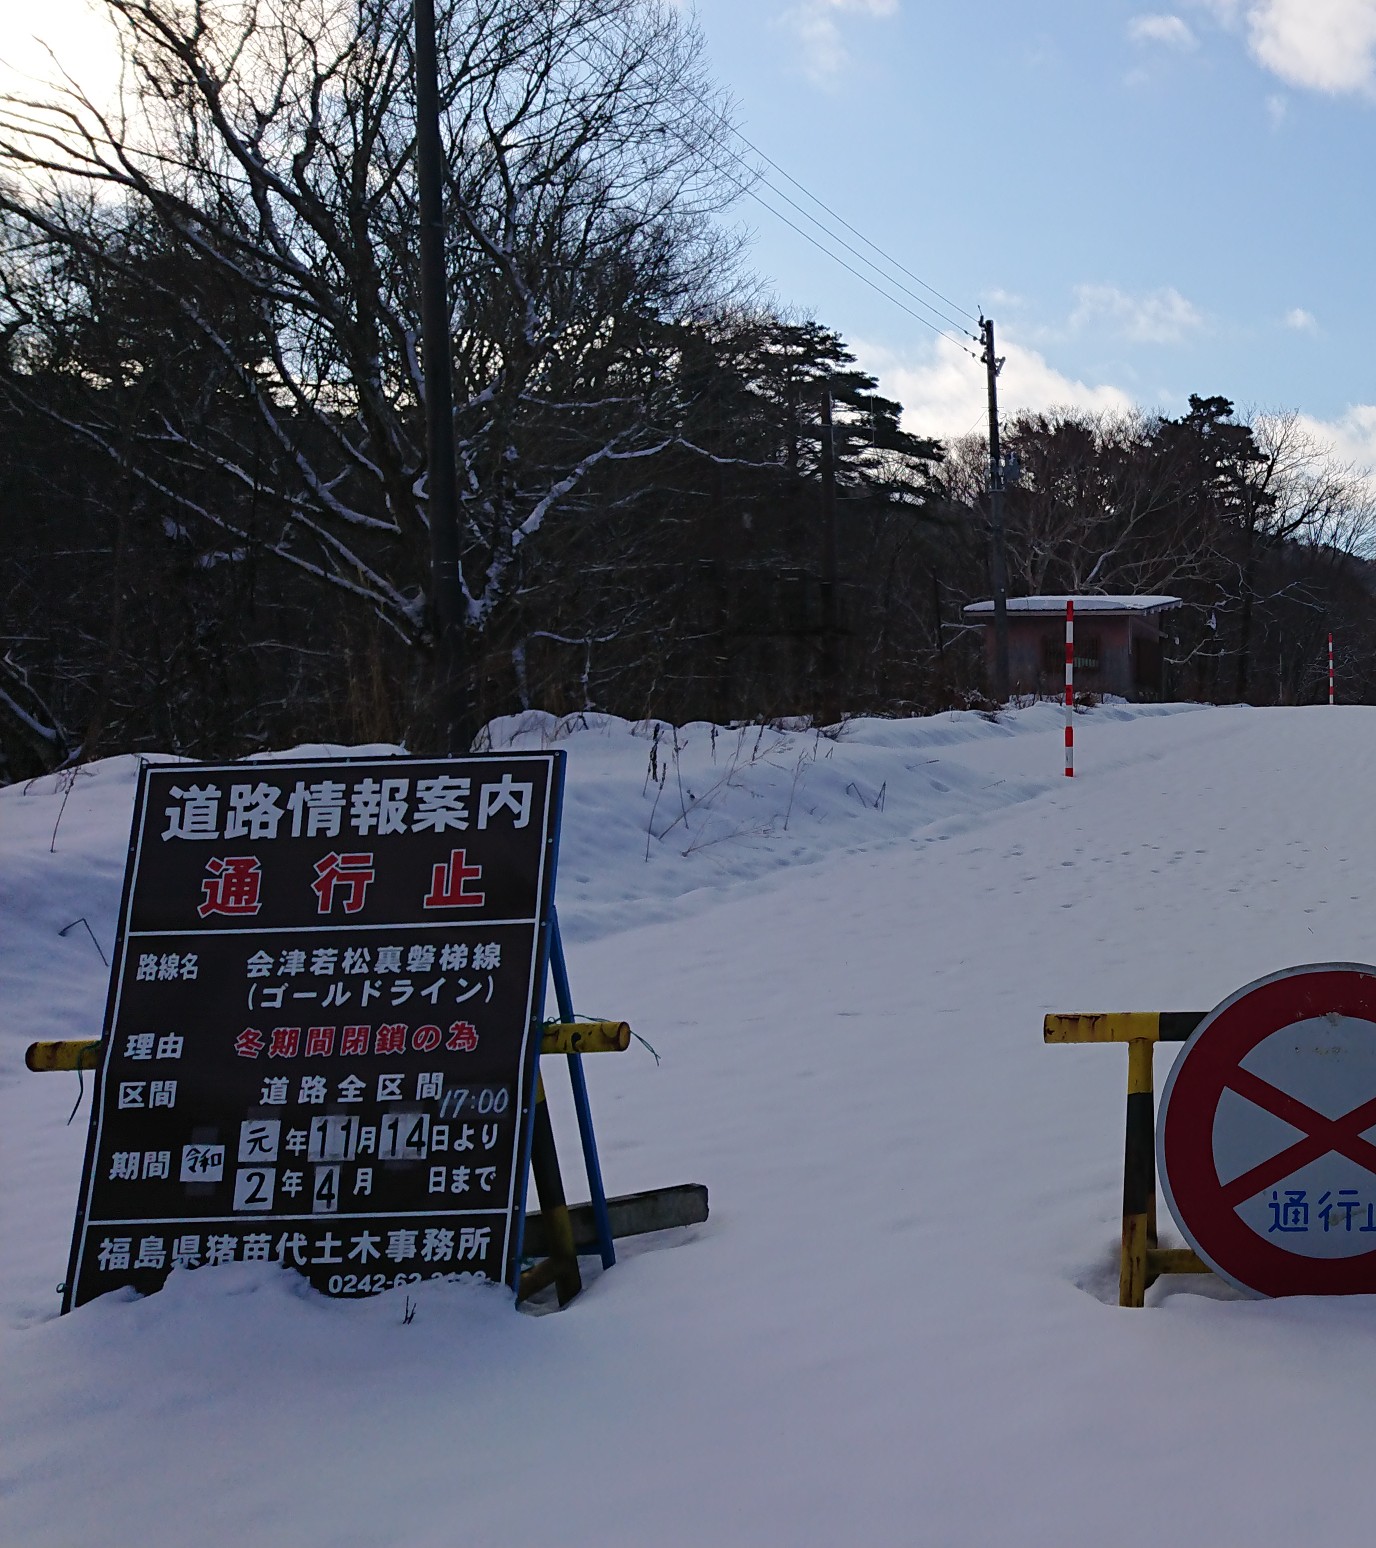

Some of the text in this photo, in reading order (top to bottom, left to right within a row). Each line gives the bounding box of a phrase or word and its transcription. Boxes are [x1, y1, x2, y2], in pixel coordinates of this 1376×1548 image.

[160, 773, 534, 842] 道路情報案内
[197, 848, 486, 919] 通行止
[135, 942, 502, 982] 路線名 会津若松裏磐梯線
[123, 1020, 479, 1060] 理由 冬期間閉鎖の為
[117, 1072, 445, 1110] 区間 道路全区間
[439, 1088, 510, 1118] 17:00
[109, 1147, 222, 1180] 期間 令和
[97, 1226, 492, 1271] 福島県猪苗代土木事務所
